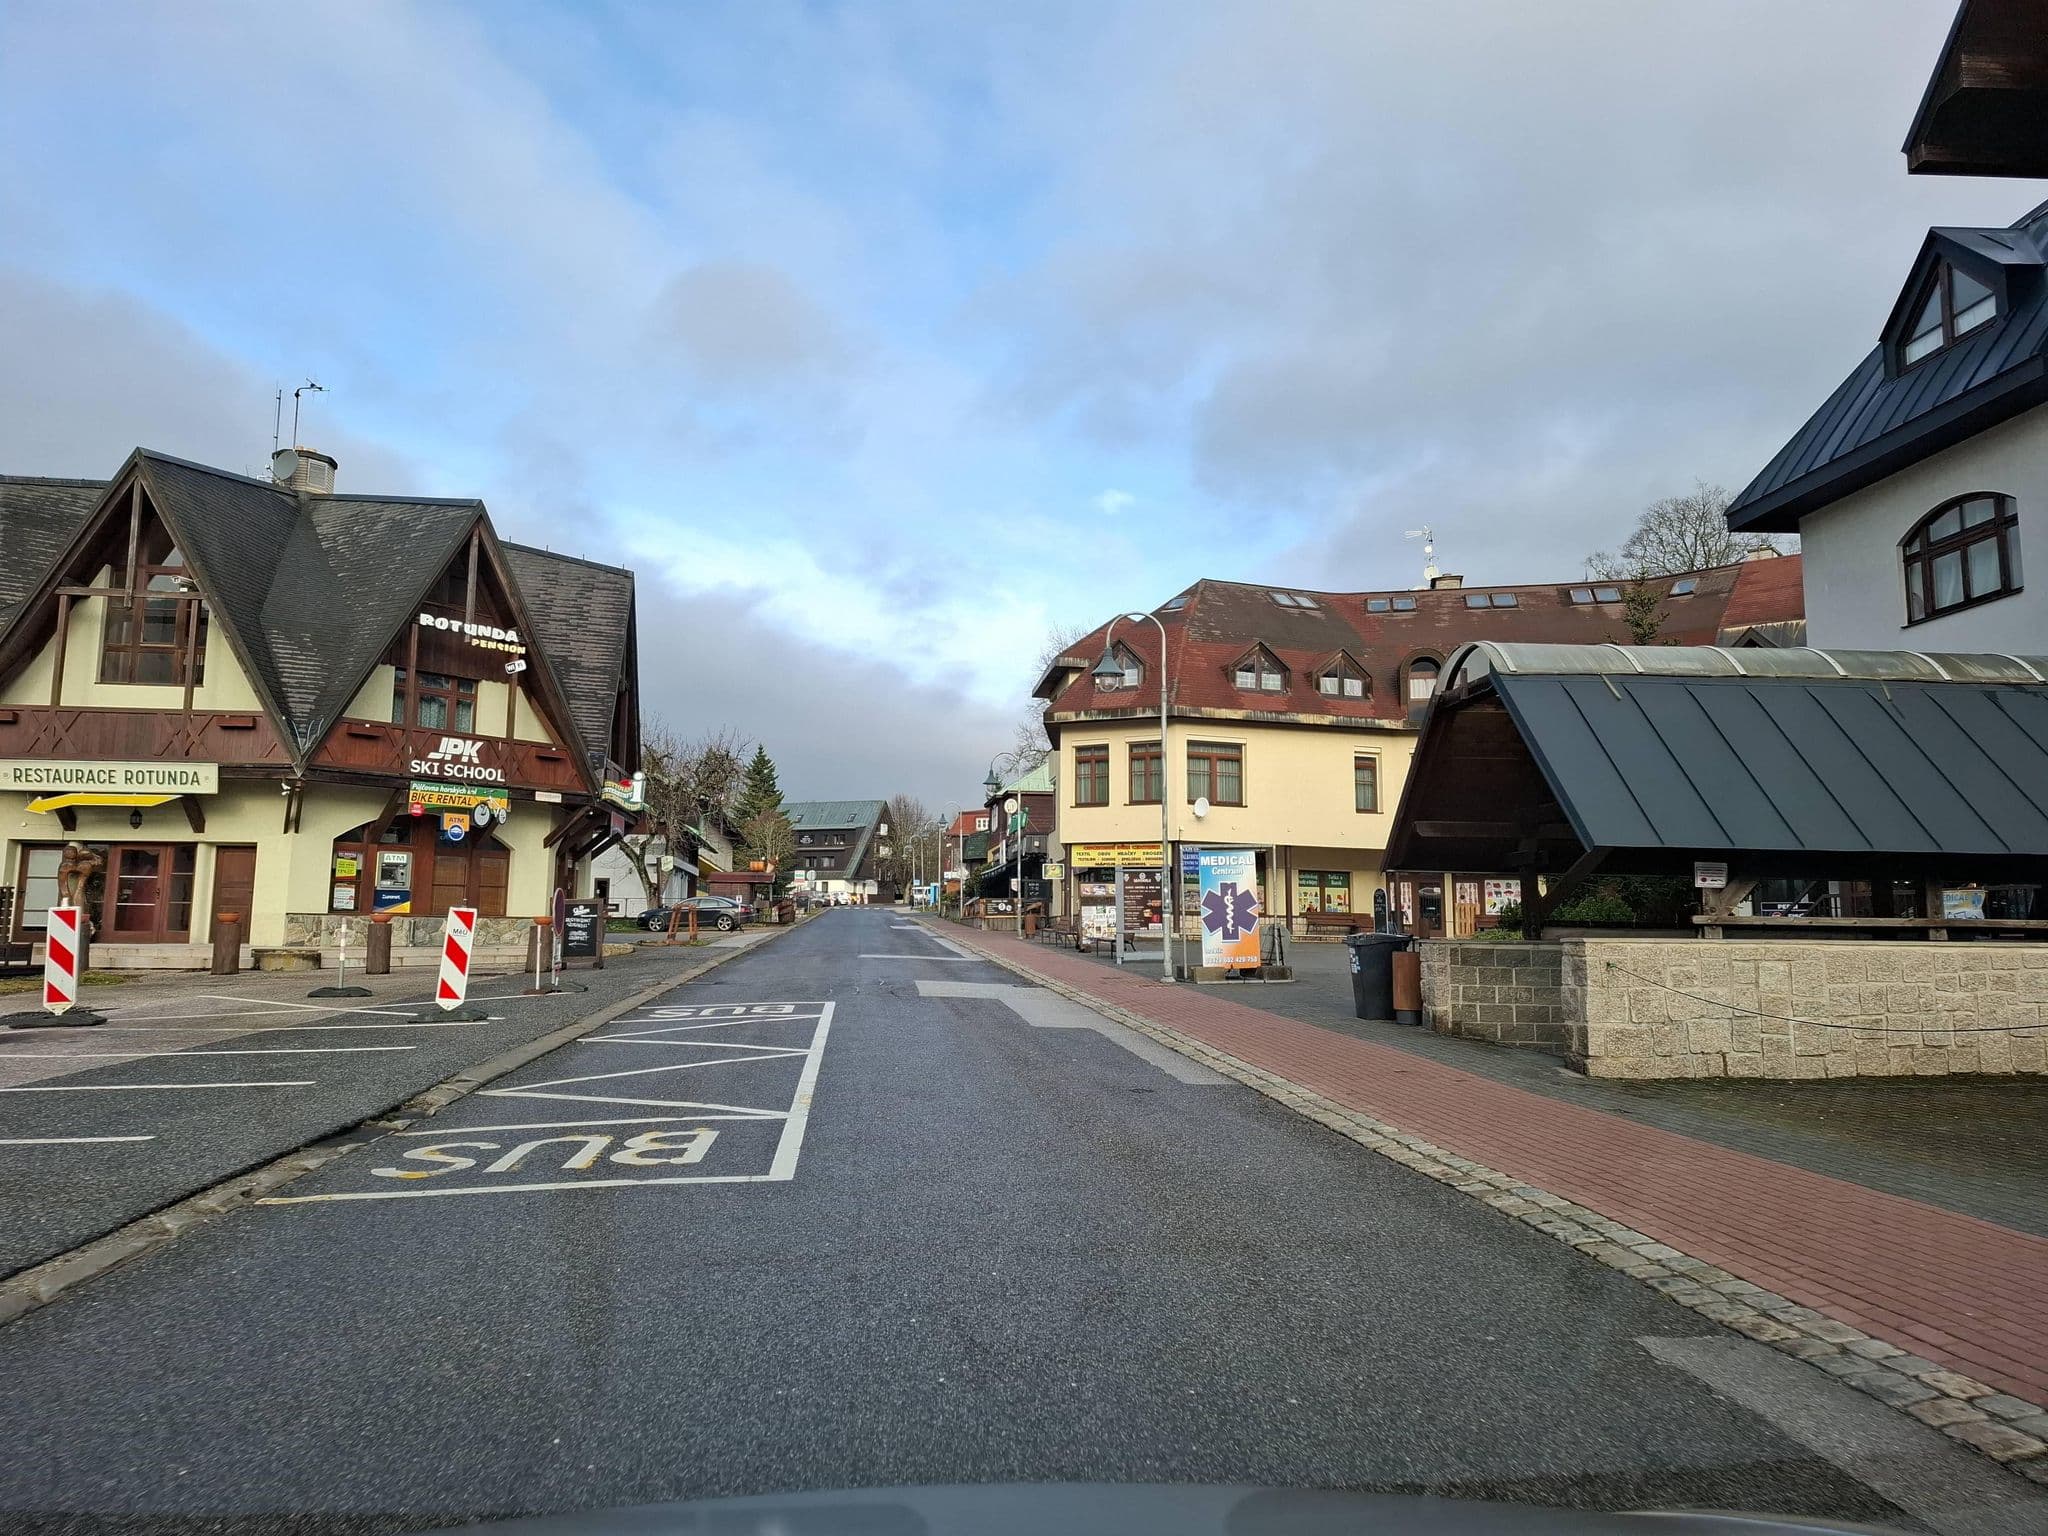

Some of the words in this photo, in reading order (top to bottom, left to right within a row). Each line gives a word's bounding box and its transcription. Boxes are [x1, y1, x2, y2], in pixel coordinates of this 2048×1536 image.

[420, 613, 518, 642] ROTUNDA
[427, 737, 484, 764] JPK
[13, 767, 116, 785] RESTAURACE
[124, 769, 201, 786] ROTUNDA
[410, 760, 439, 775] SKI
[443, 764, 505, 782] SCHOOL
[411, 792, 434, 803] BIKE
[436, 795, 472, 806] RENTAL
[1200, 855, 1255, 866] MEDICAL
[649, 1004, 795, 1019] BUS
[370, 1127, 720, 1180] BUS
